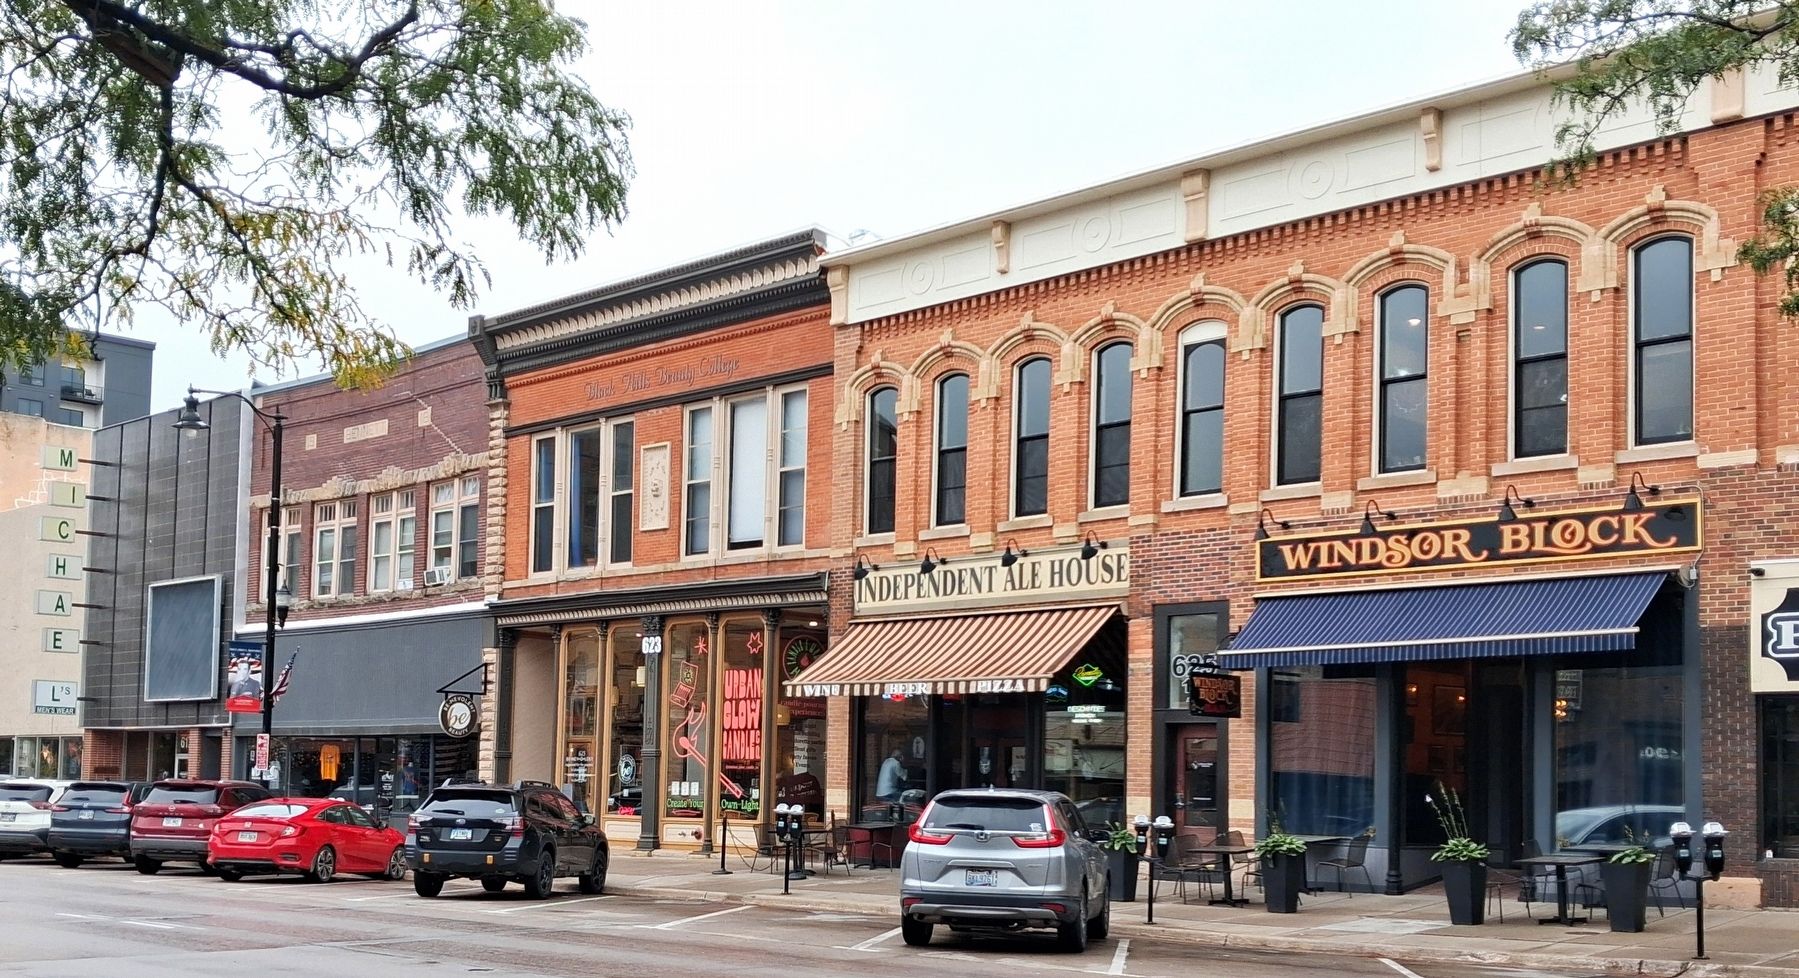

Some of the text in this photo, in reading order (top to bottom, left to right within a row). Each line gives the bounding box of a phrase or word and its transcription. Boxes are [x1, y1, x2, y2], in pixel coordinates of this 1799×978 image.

[584, 355, 740, 400] Black Hills Beauty College
[1279, 512, 1677, 571] WINDSOR BLOCK
[857, 552, 1128, 603] INDEPENDENT ALE HOUSE
[642, 636, 661, 653] 623
[725, 668, 761, 699] URBAN
[803, 679, 1024, 697] WINE BEER PIZZA
[1193, 677, 1238, 695] WINDSOR
[1199, 688, 1233, 704] BLOCK
[36, 706, 74, 715] MEN'S WEAR
[723, 699, 760, 729] GLOW
[448, 727, 469, 736] BEAUTY
[723, 729, 755, 760] CANDLE
[666, 798, 704, 808] Create Your
[721, 798, 738, 809] Own
